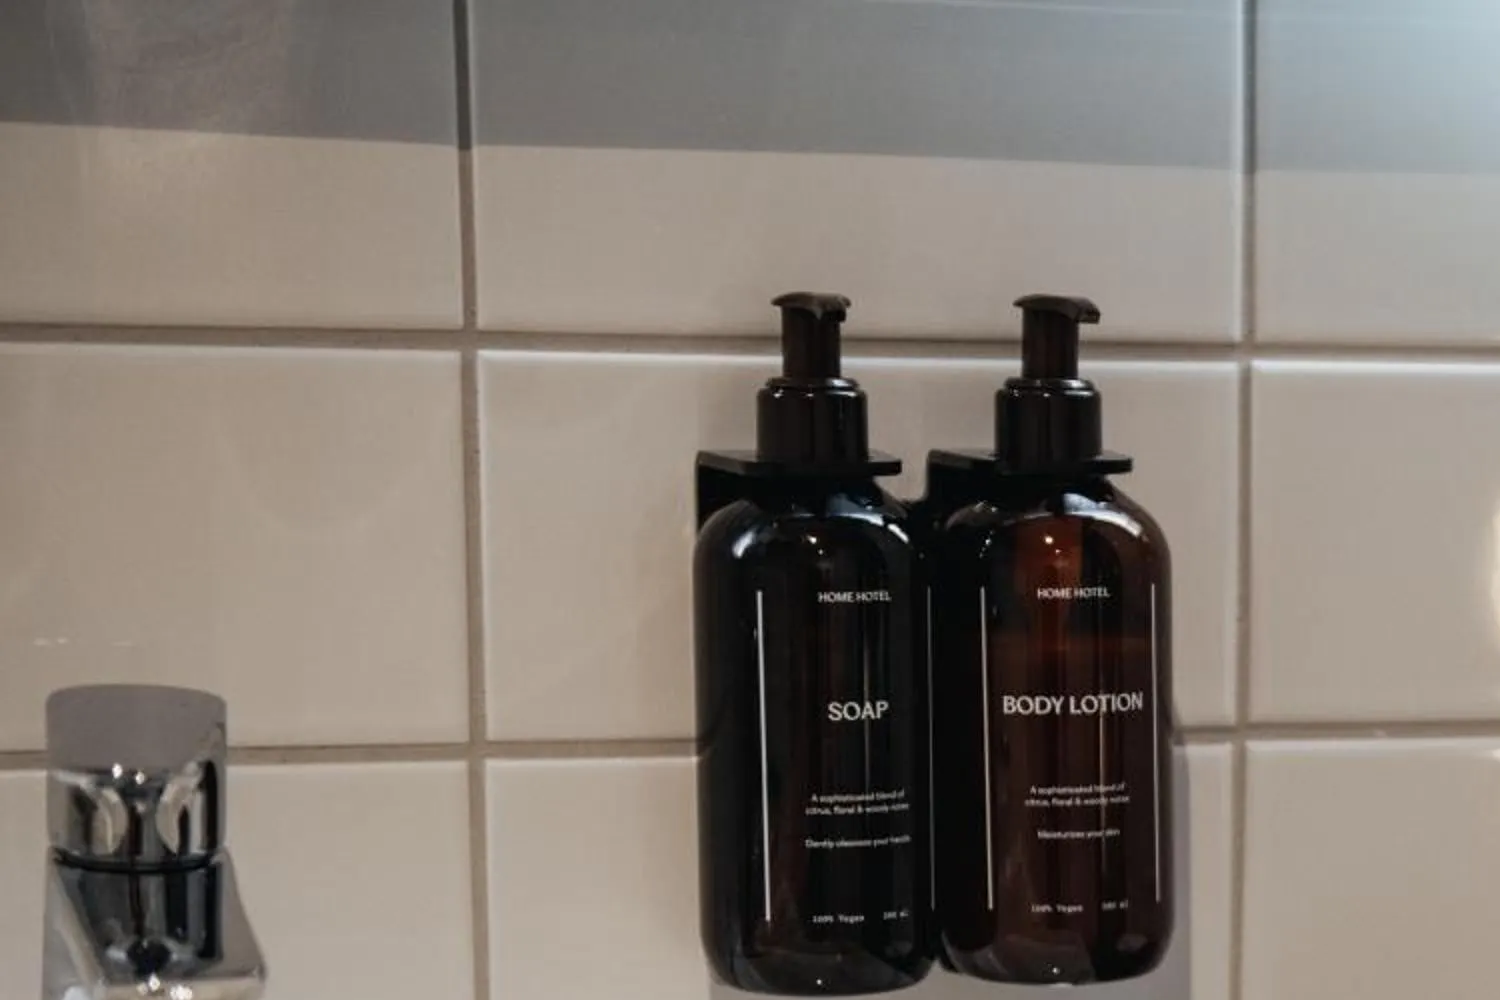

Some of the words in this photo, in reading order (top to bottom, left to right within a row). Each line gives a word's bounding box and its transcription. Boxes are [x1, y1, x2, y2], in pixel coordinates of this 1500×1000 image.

[817, 591, 854, 603] HOME
[855, 589, 892, 602] HOTEL
[1037, 587, 1072, 599] HOME
[1073, 586, 1110, 599] HOTEL
[827, 700, 889, 721] SOAP
[1002, 695, 1064, 715] BODY
[1069, 691, 1143, 715] LOTION
